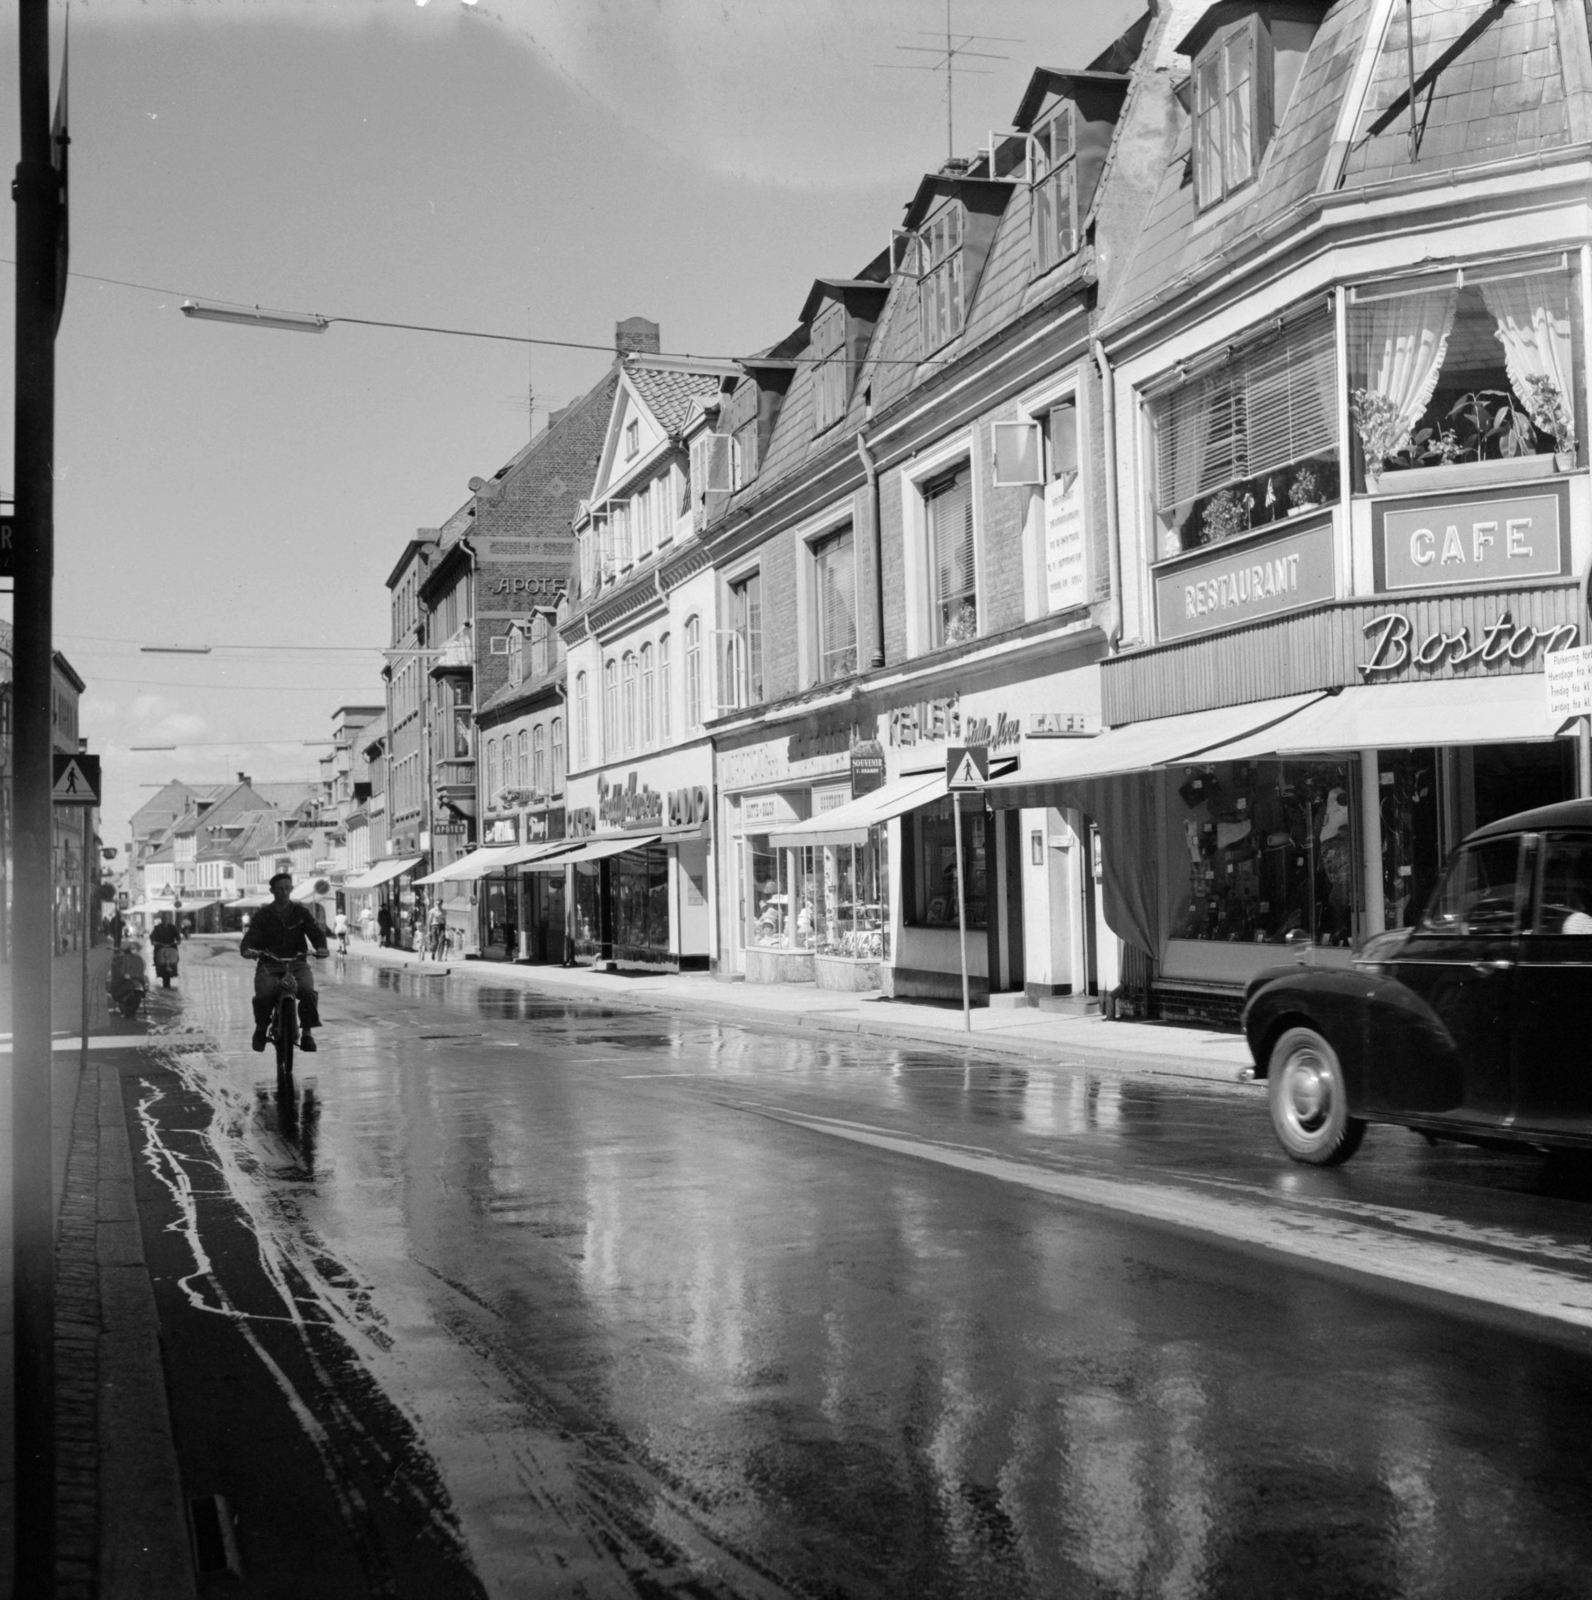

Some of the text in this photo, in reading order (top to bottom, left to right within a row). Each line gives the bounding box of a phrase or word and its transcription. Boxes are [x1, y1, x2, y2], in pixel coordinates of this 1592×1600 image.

[1410, 518, 1533, 567] CAFE
[489, 577, 567, 596] APOTE
[1185, 554, 1300, 619] RESTAURANT
[1358, 613, 1578, 674] Boston
[1553, 654, 1580, 666] Parkering
[1548, 669, 1574, 682] Hverdage
[1577, 666, 1585, 676] fra
[1572, 683, 1580, 693] fra
[1573, 699, 1581, 709] fra
[1031, 714, 1085, 732] CAFE
[852, 758, 883, 768] SOUVENIR
[436, 824, 465, 833] APOTEK
